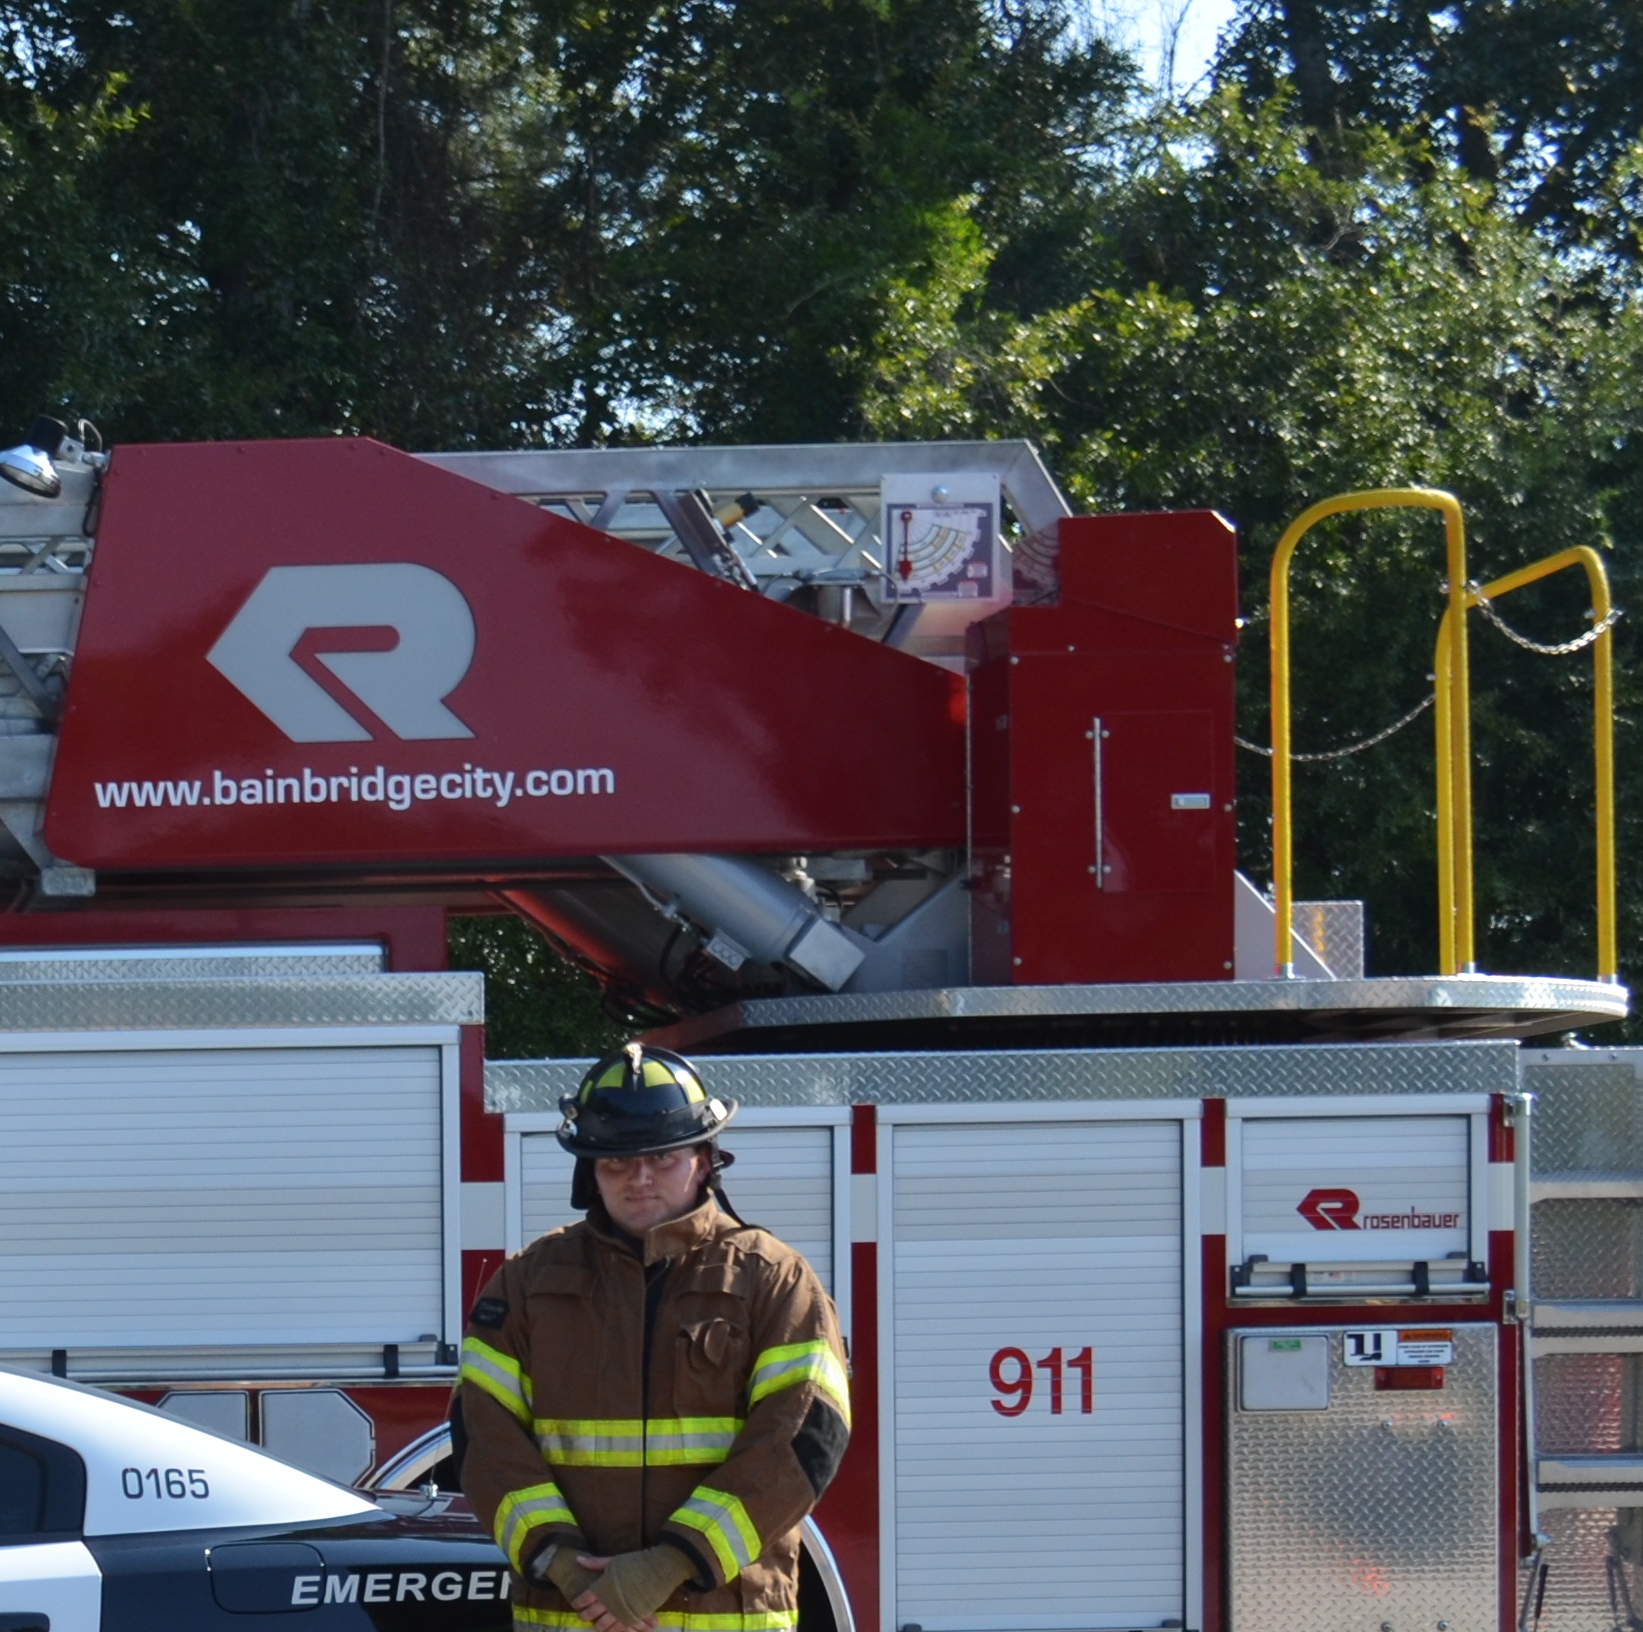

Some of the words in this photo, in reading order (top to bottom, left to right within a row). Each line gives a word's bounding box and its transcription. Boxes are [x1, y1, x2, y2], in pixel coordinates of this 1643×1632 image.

[94, 763, 616, 811] www.bainbridgecity.com
[1364, 1206, 1460, 1230] rosenbauer
[988, 1346, 1093, 1417] 911
[120, 1467, 211, 1501] 0165
